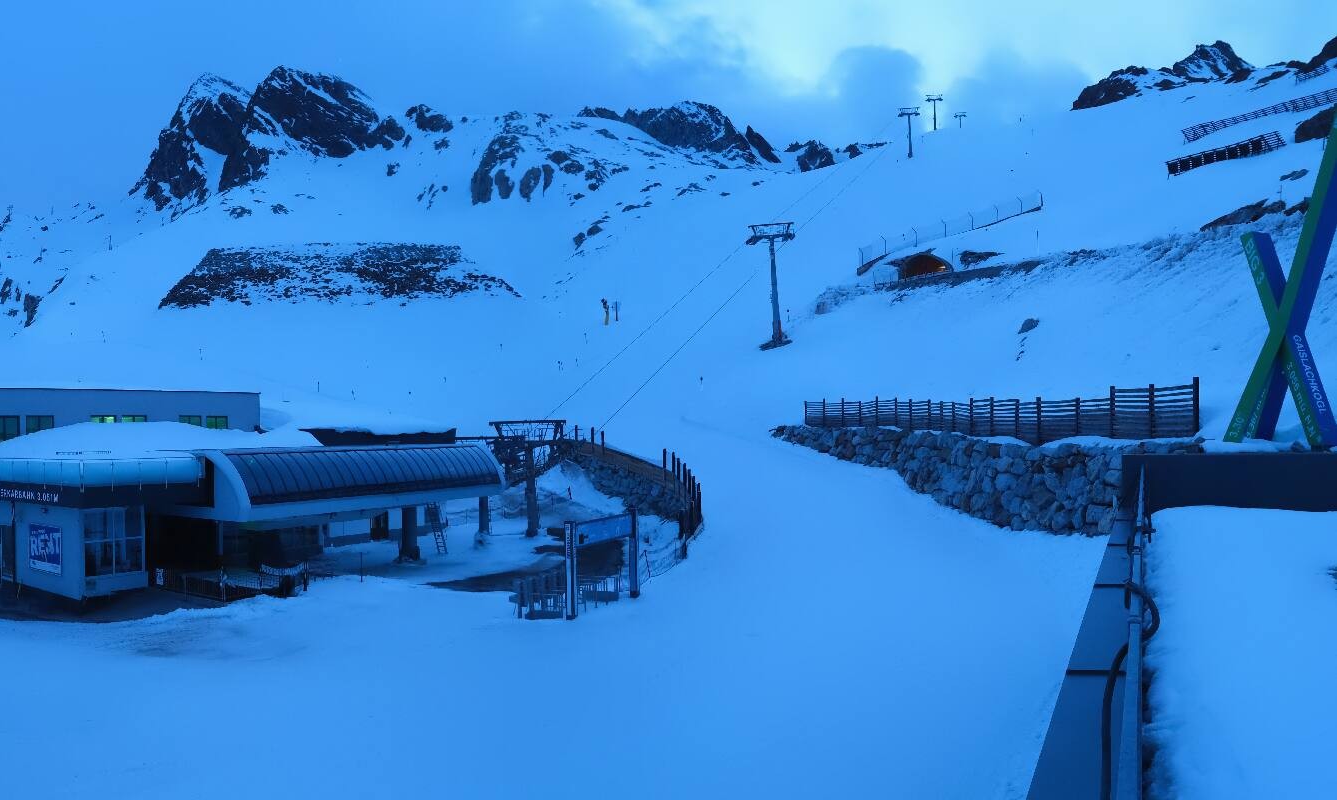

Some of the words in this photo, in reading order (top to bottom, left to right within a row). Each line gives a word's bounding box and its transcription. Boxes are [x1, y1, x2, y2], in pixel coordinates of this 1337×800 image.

[1246, 239, 1260, 271] BIG
[1257, 272, 1265, 285] 3
[1293, 335, 1327, 414] GAISLACHKOGL
